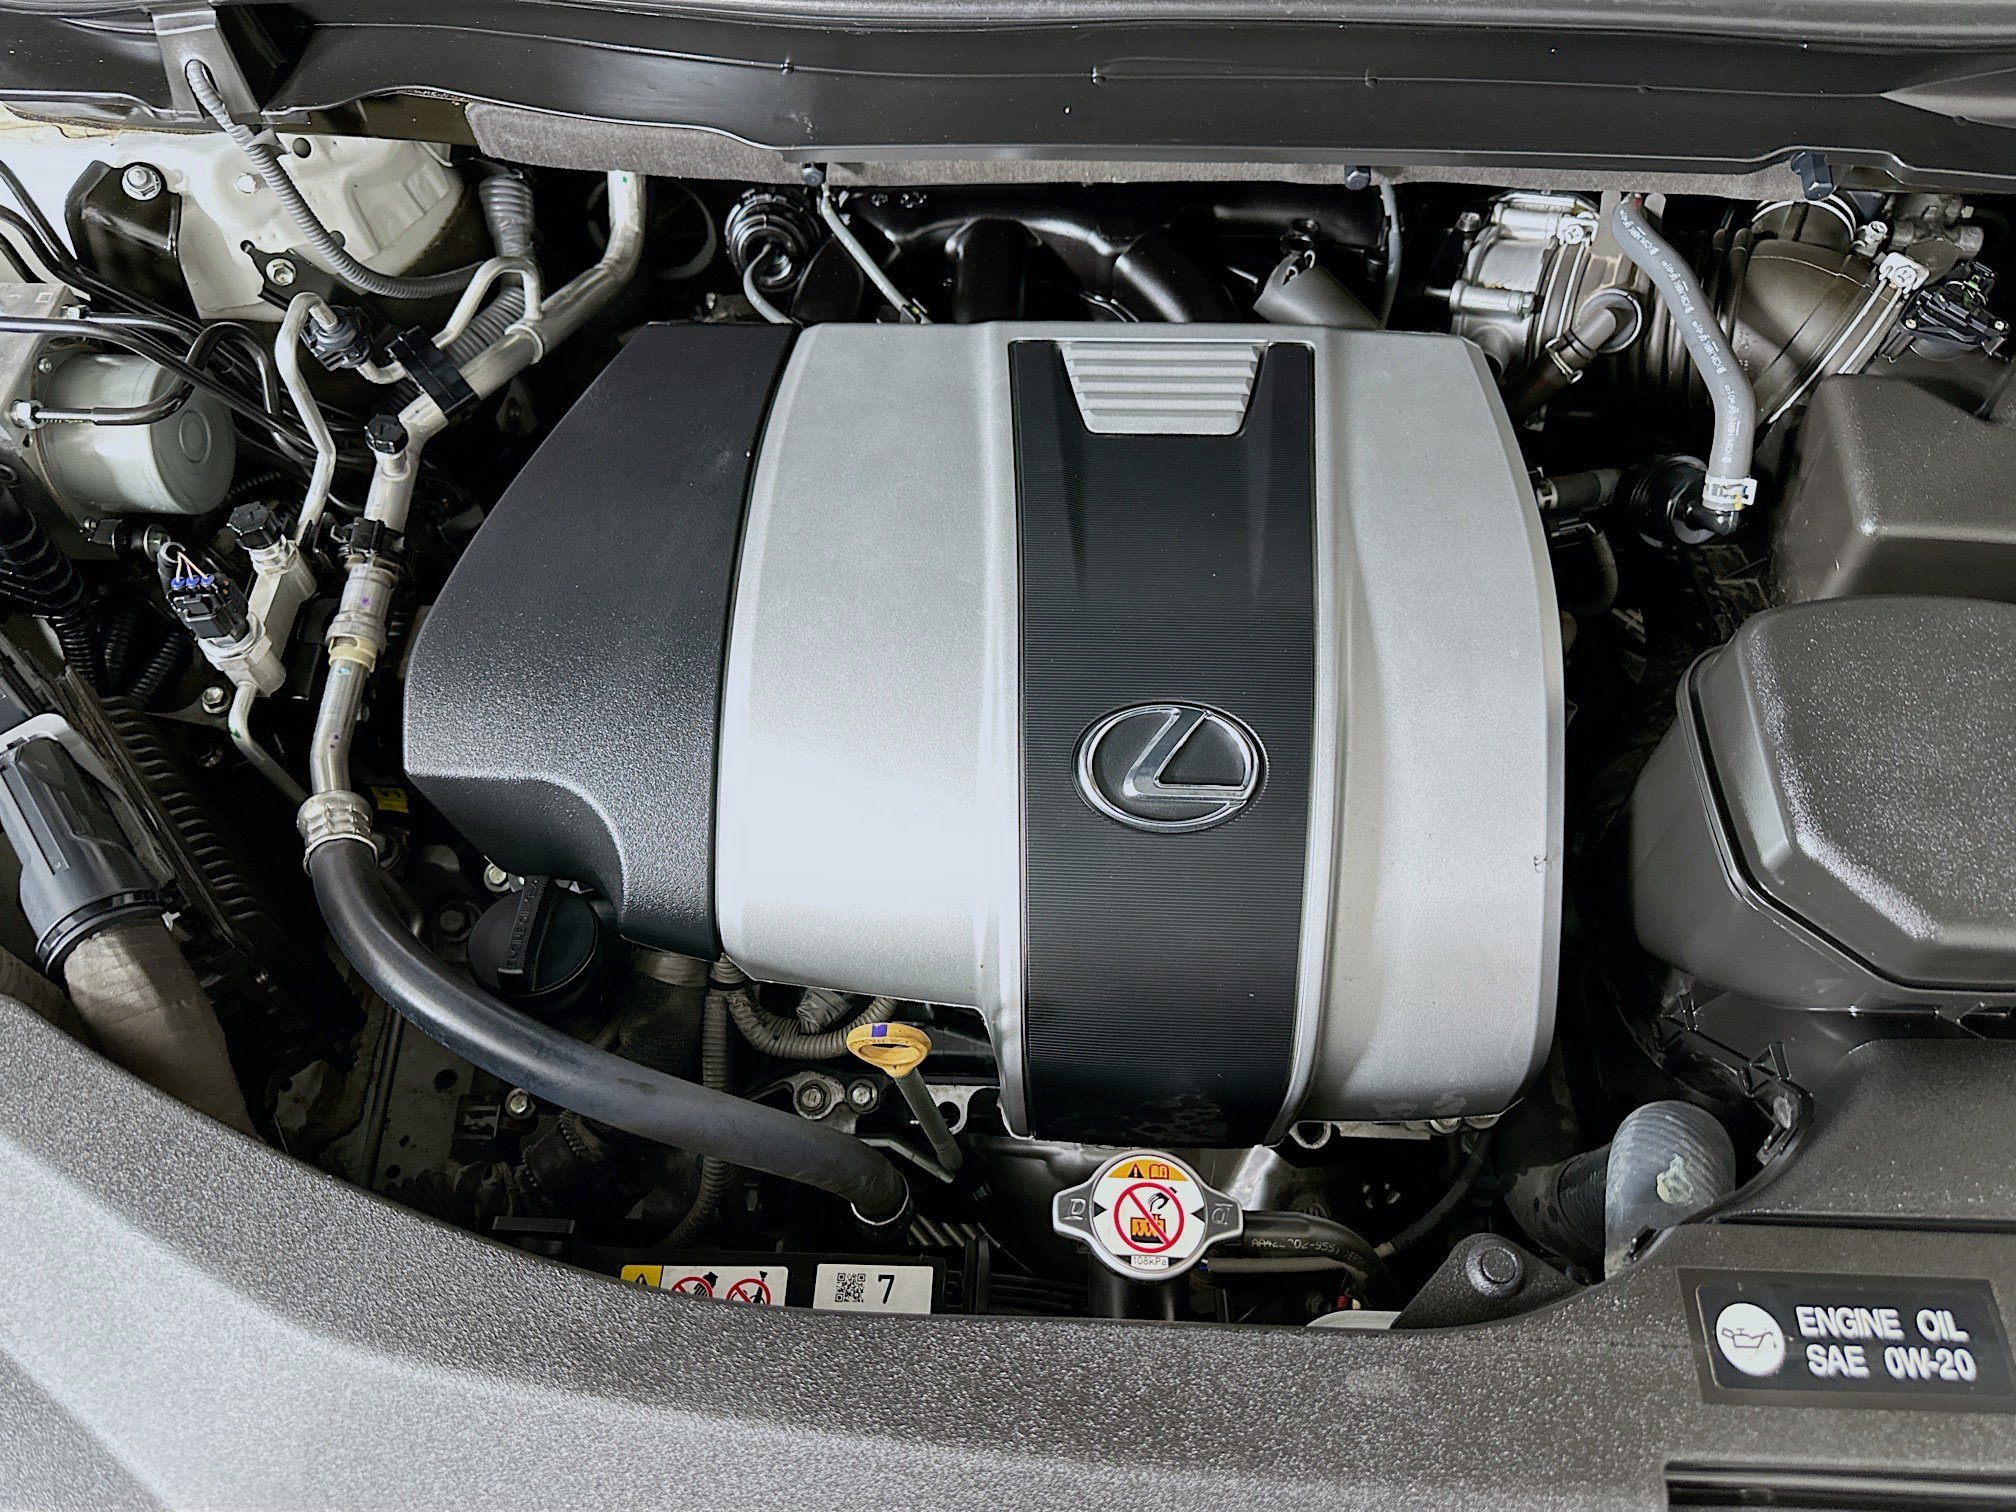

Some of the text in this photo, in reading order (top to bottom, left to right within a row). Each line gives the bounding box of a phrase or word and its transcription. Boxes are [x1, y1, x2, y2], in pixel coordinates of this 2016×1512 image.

[1132, 1256, 1168, 1267] 108kPa
[878, 1274, 895, 1304] 7
[1795, 1306, 1970, 1342] ENGINE OIL
[1806, 1343, 1977, 1382] SAE 0W-20
